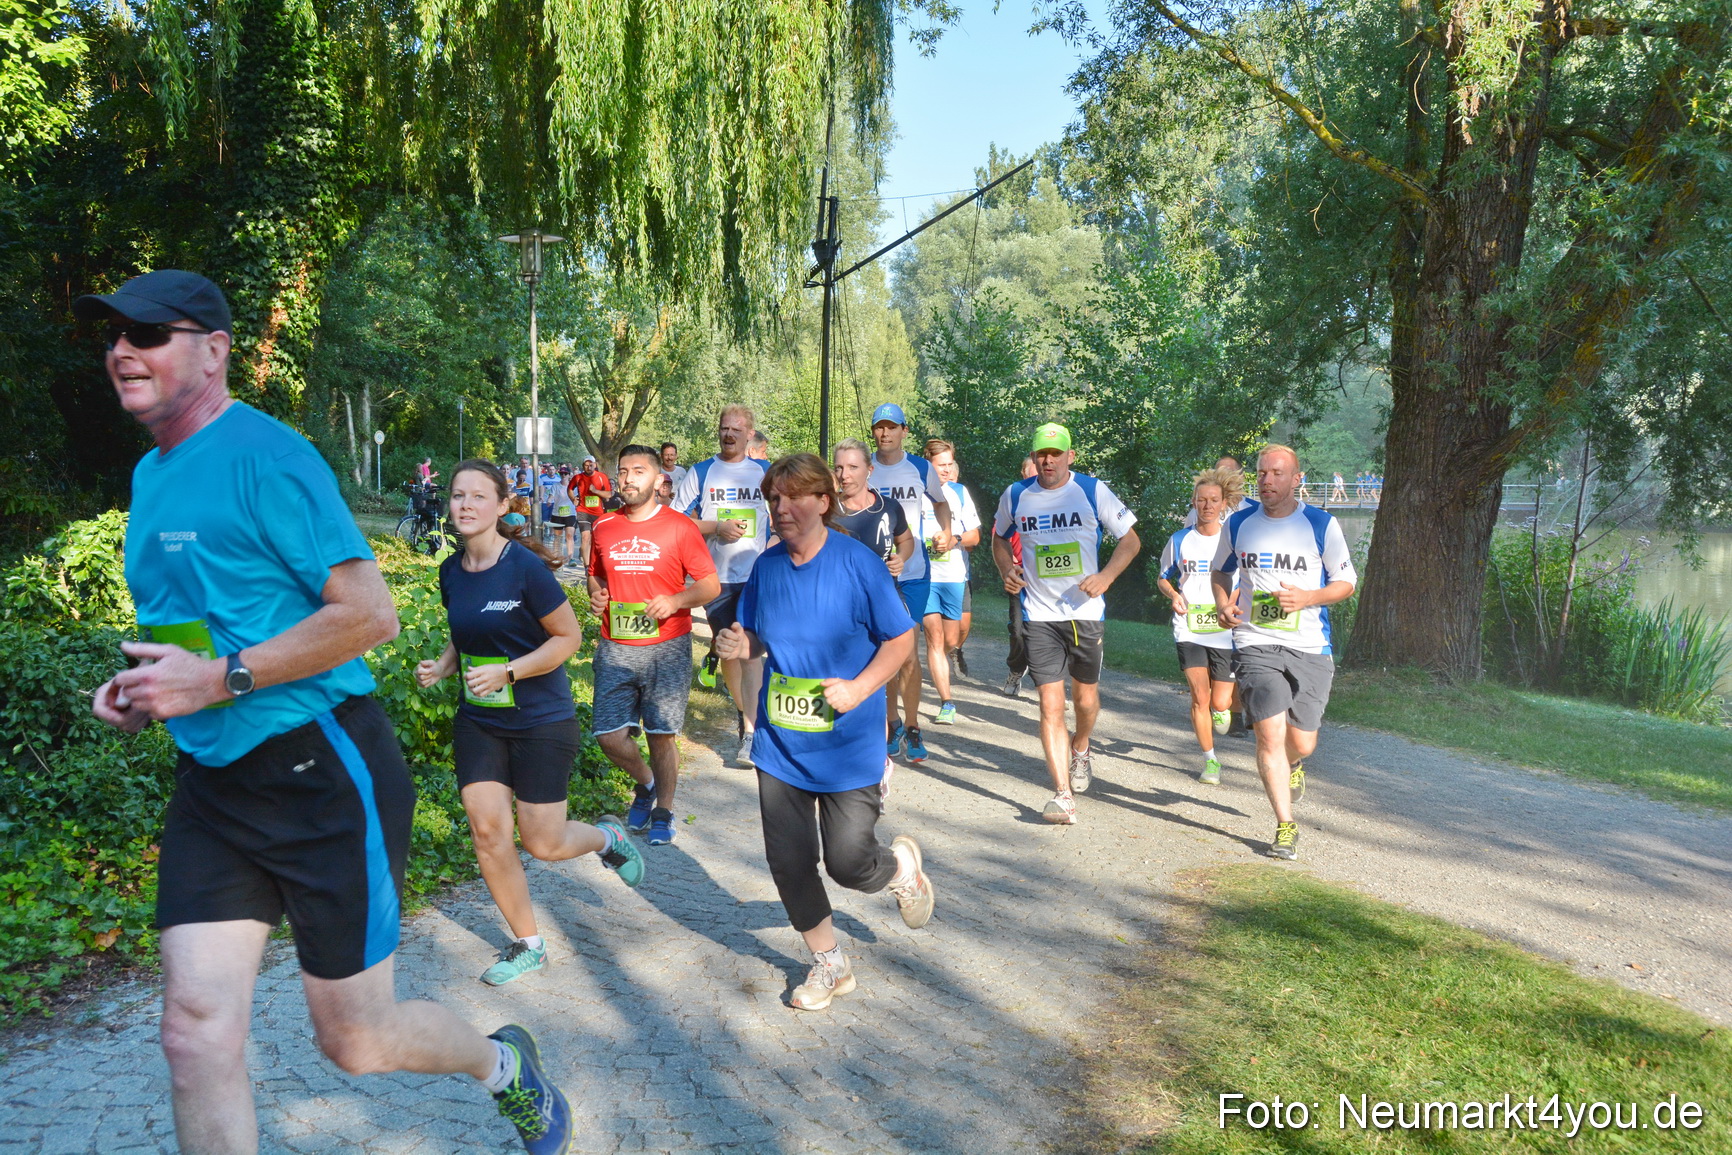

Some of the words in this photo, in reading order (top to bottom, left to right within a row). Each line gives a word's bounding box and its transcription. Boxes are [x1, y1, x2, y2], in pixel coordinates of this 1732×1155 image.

[709, 488, 762, 502] iREMA
[1021, 511, 1083, 533] iREMA
[1045, 554, 1072, 569] 828
[1240, 551, 1308, 572] iREMA
[1196, 613, 1218, 625] 829
[1260, 604, 1290, 621] 830
[615, 613, 652, 629] 1716
[774, 693, 825, 718] 1092
